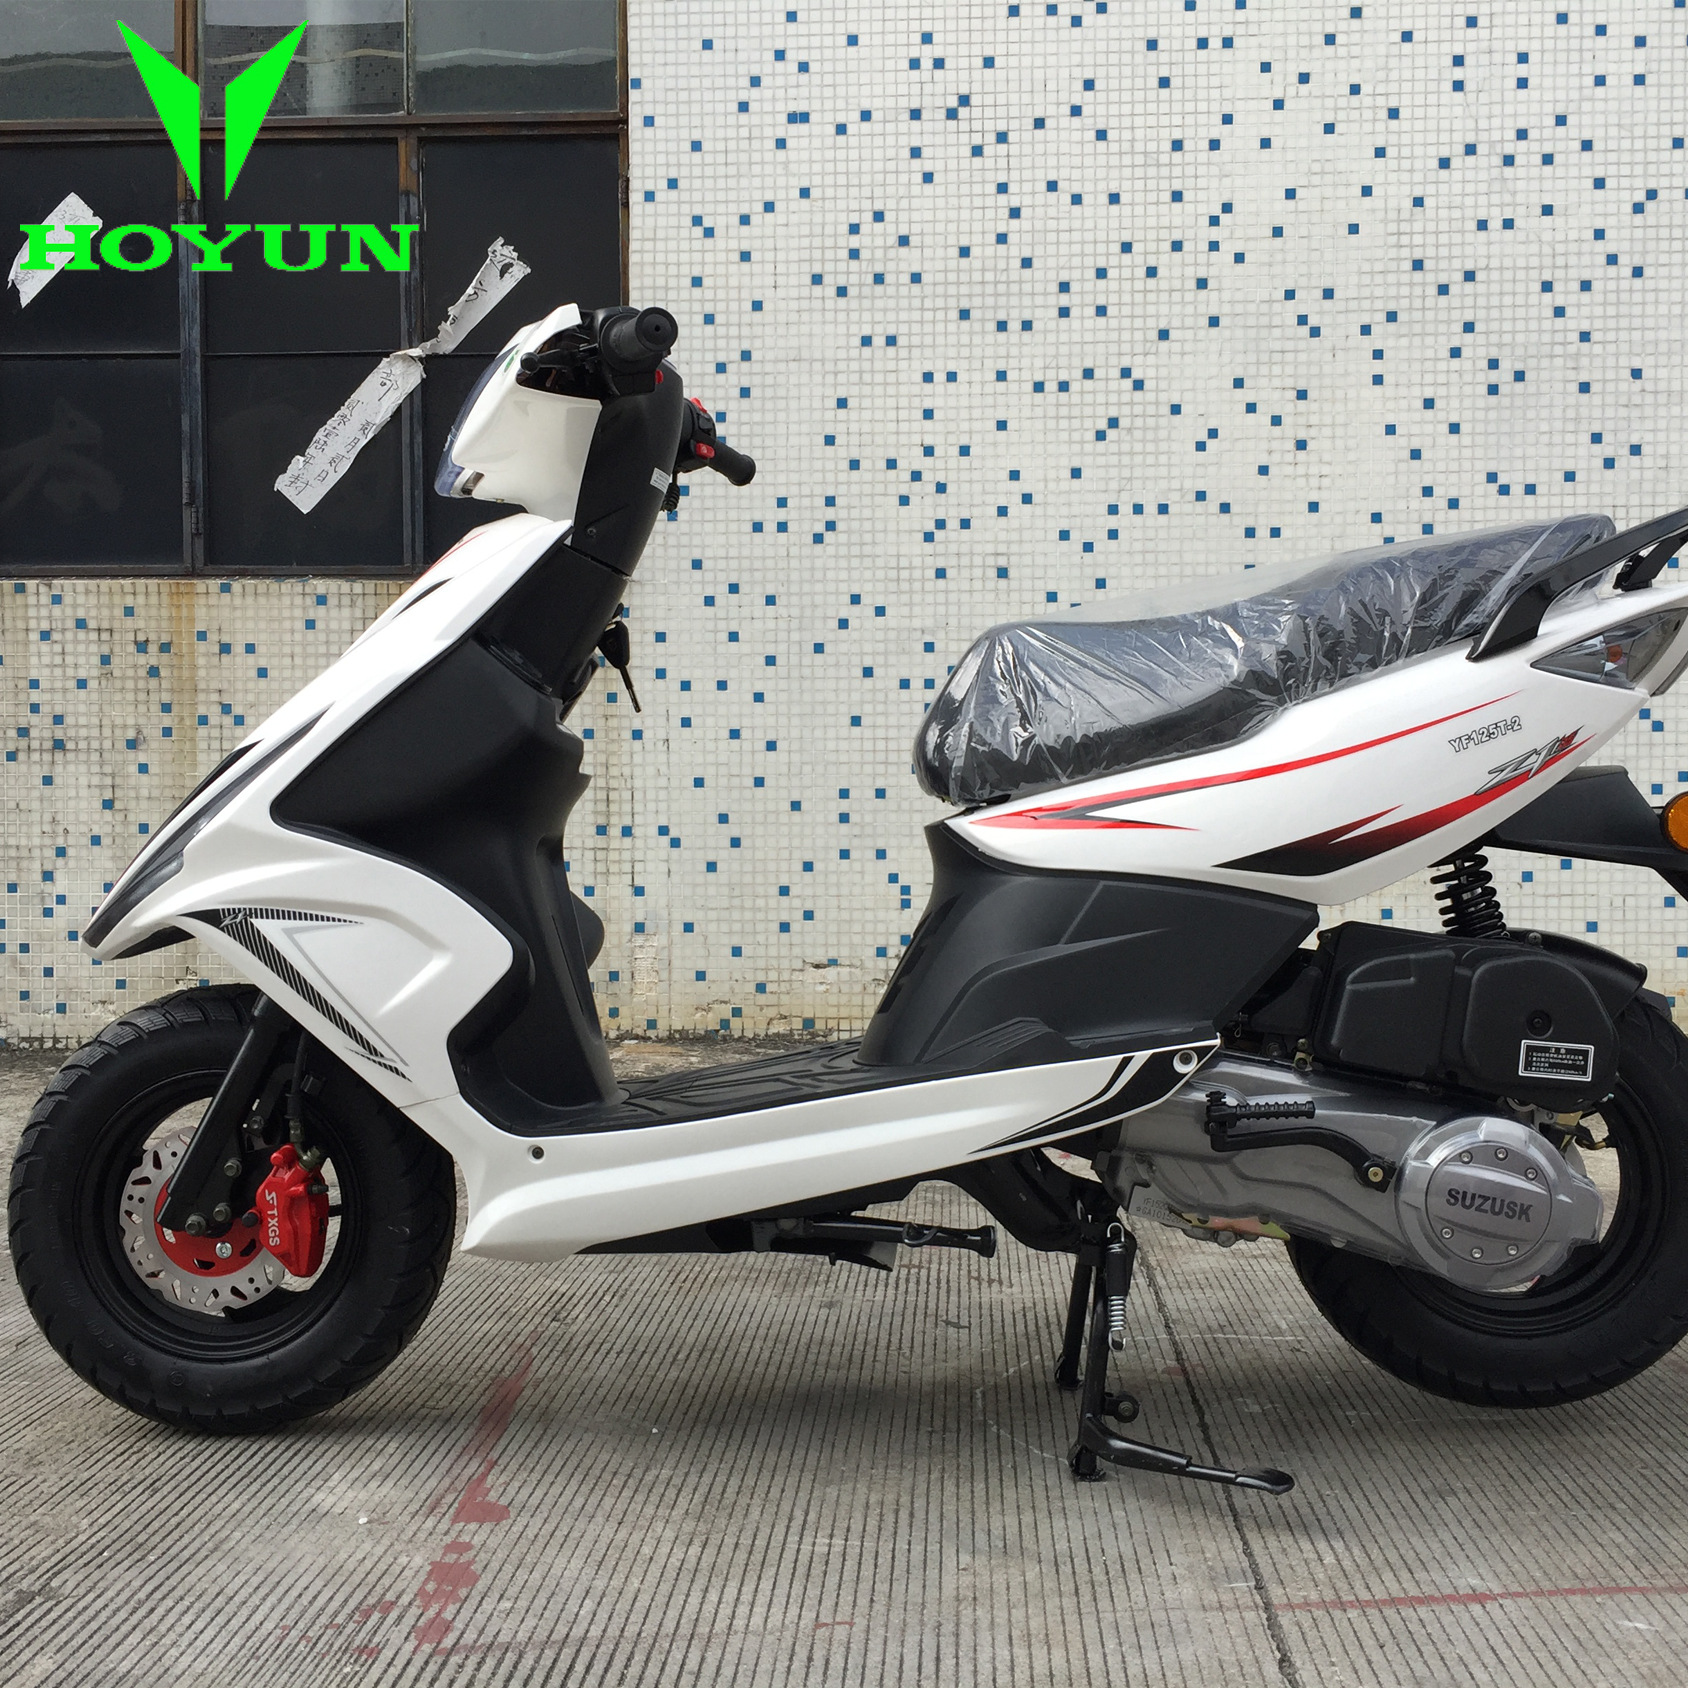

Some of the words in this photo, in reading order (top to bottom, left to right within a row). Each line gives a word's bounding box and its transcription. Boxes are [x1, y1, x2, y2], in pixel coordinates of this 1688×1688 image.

[1448, 715, 1522, 753] YF125T-2
[265, 1189, 280, 1246] STXGS
[1446, 1188, 1533, 1222] SUZUSK
